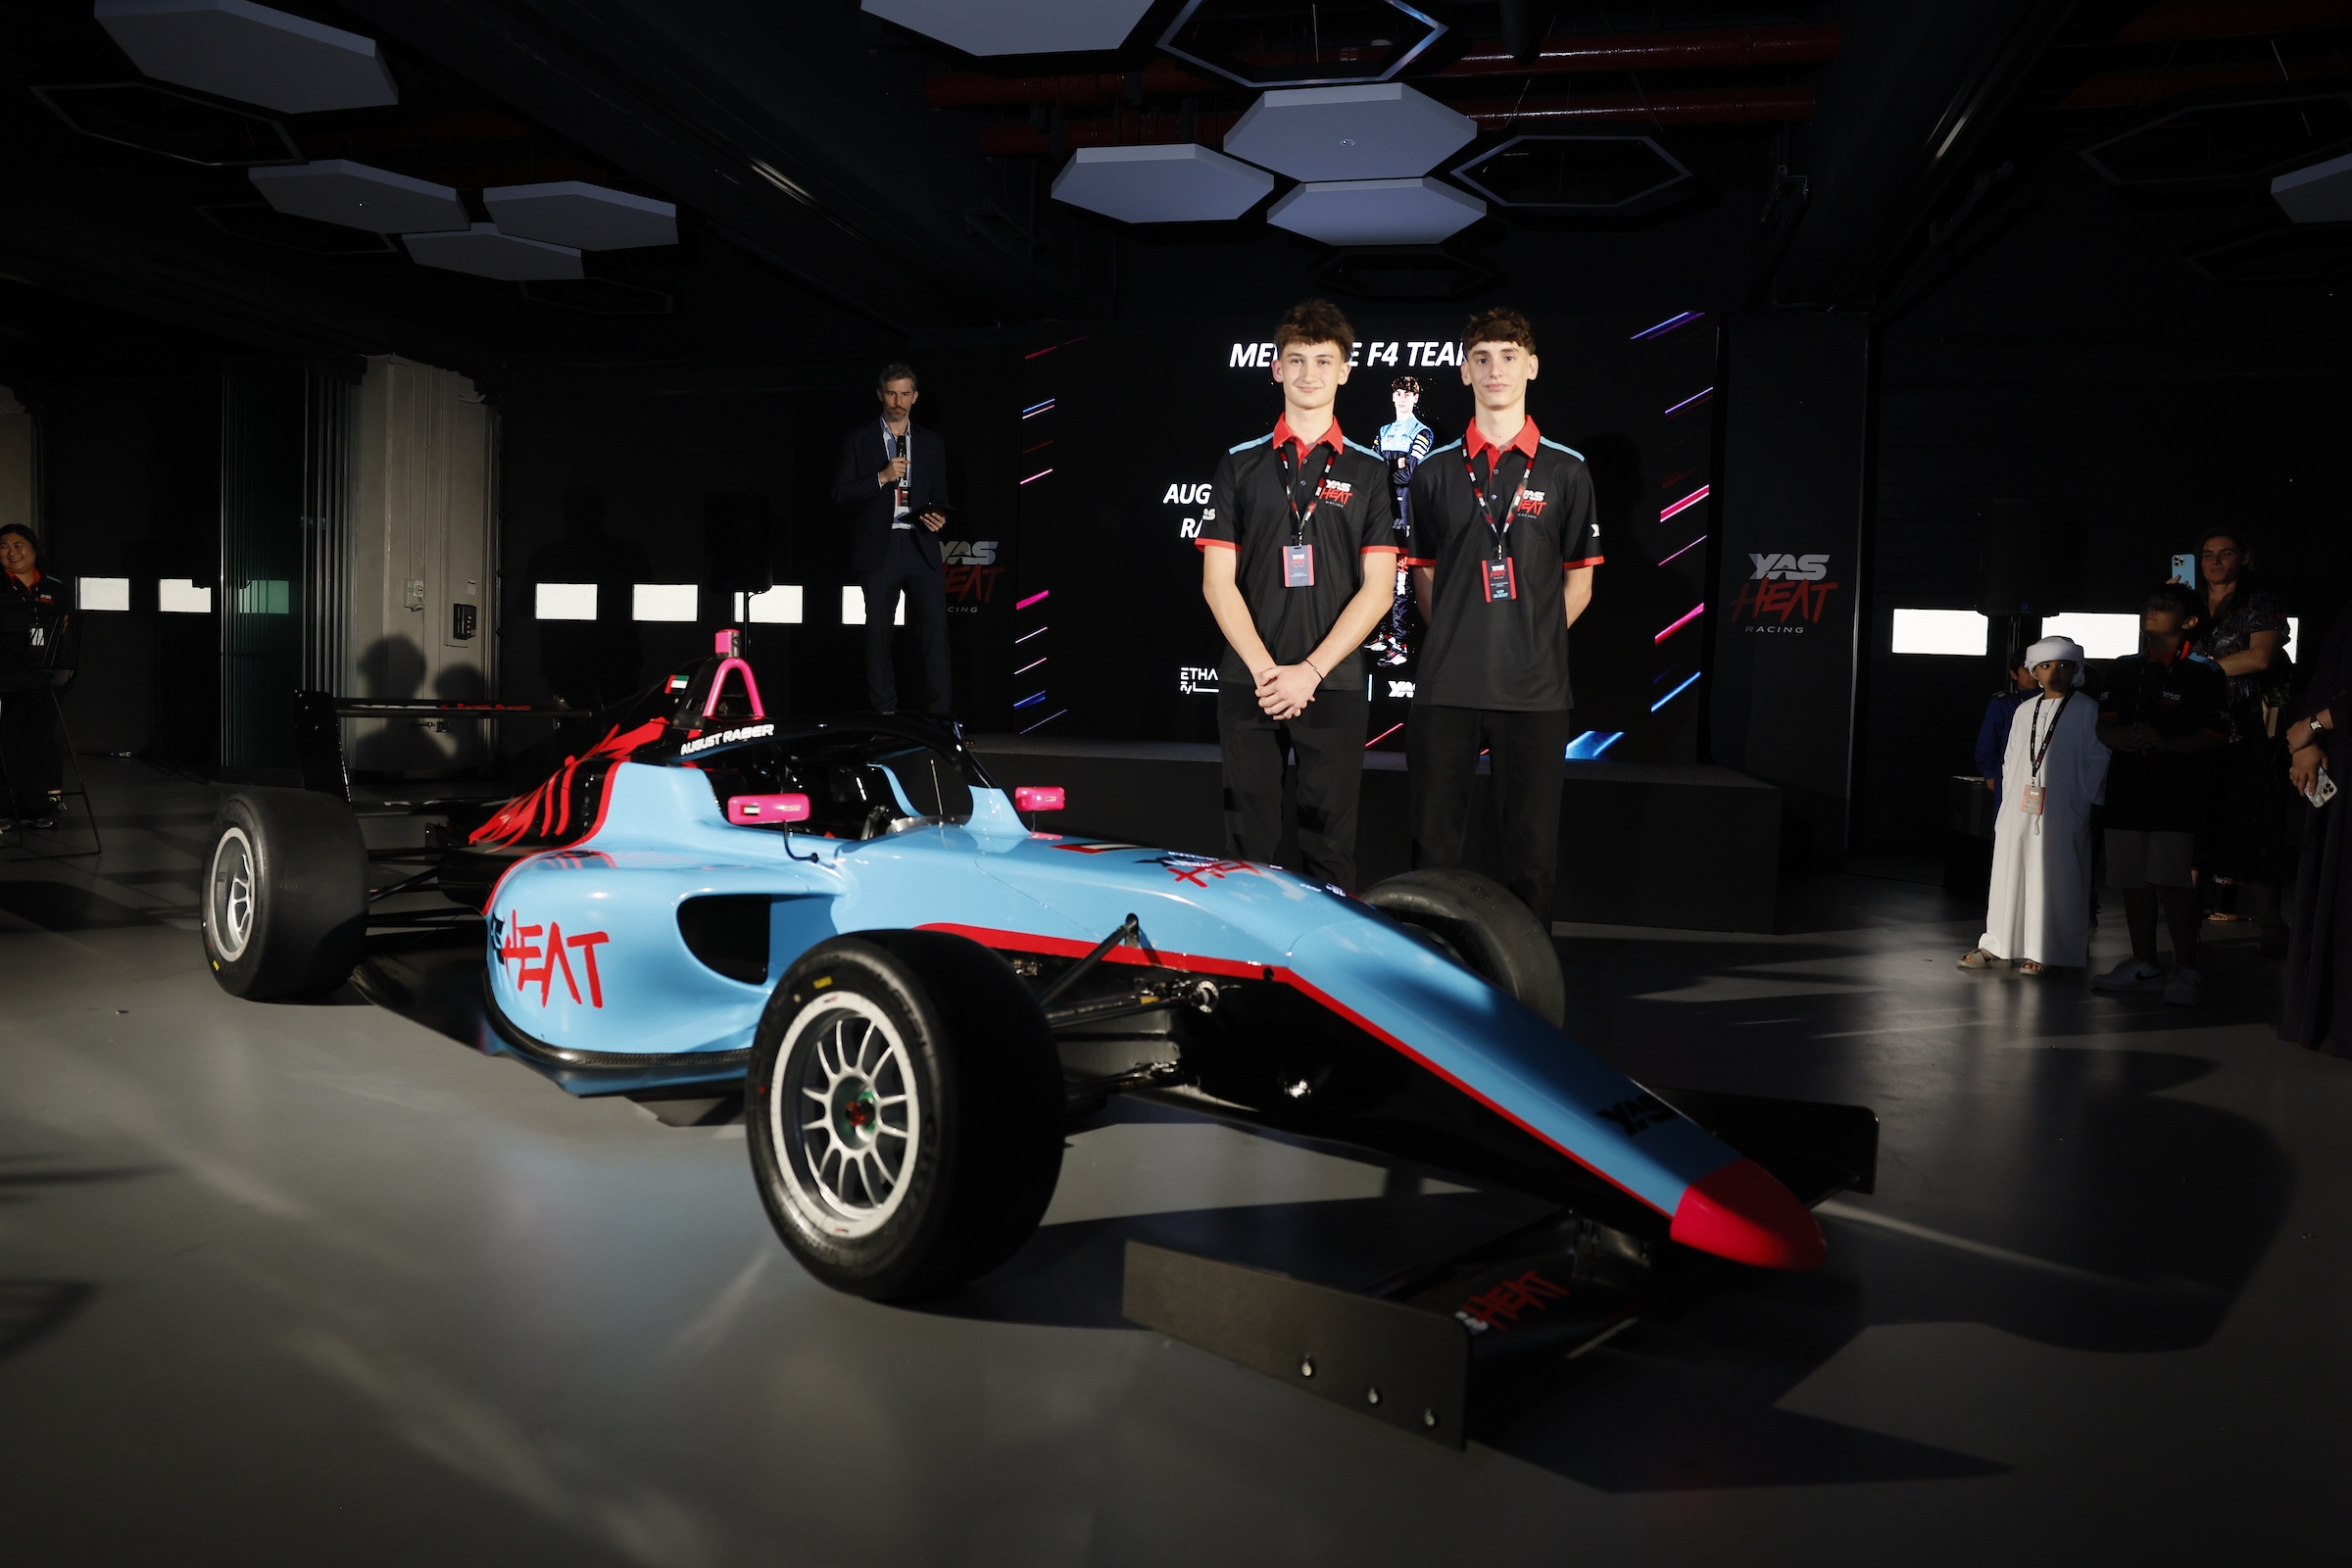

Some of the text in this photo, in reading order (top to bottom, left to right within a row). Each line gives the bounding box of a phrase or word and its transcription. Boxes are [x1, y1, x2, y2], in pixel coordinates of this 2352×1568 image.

[1367, 342, 1399, 367] F4
[1162, 483, 1212, 505] AUG
[1319, 487, 1353, 506] HEAT
[1325, 478, 1351, 493] YAS
[1522, 489, 1545, 503] AS
[938, 540, 1000, 566] YAS
[1747, 553, 1831, 581] YAS
[943, 562, 1006, 604] EAT
[1729, 576, 1839, 623] HEAT
[1744, 625, 1805, 634] RACING
[1180, 666, 1219, 681] ETHA
[1387, 679, 1417, 699] YA
[680, 732, 723, 756] AUGUST
[501, 908, 610, 1009] HEAT
[1461, 1269, 1572, 1332] HEAT
